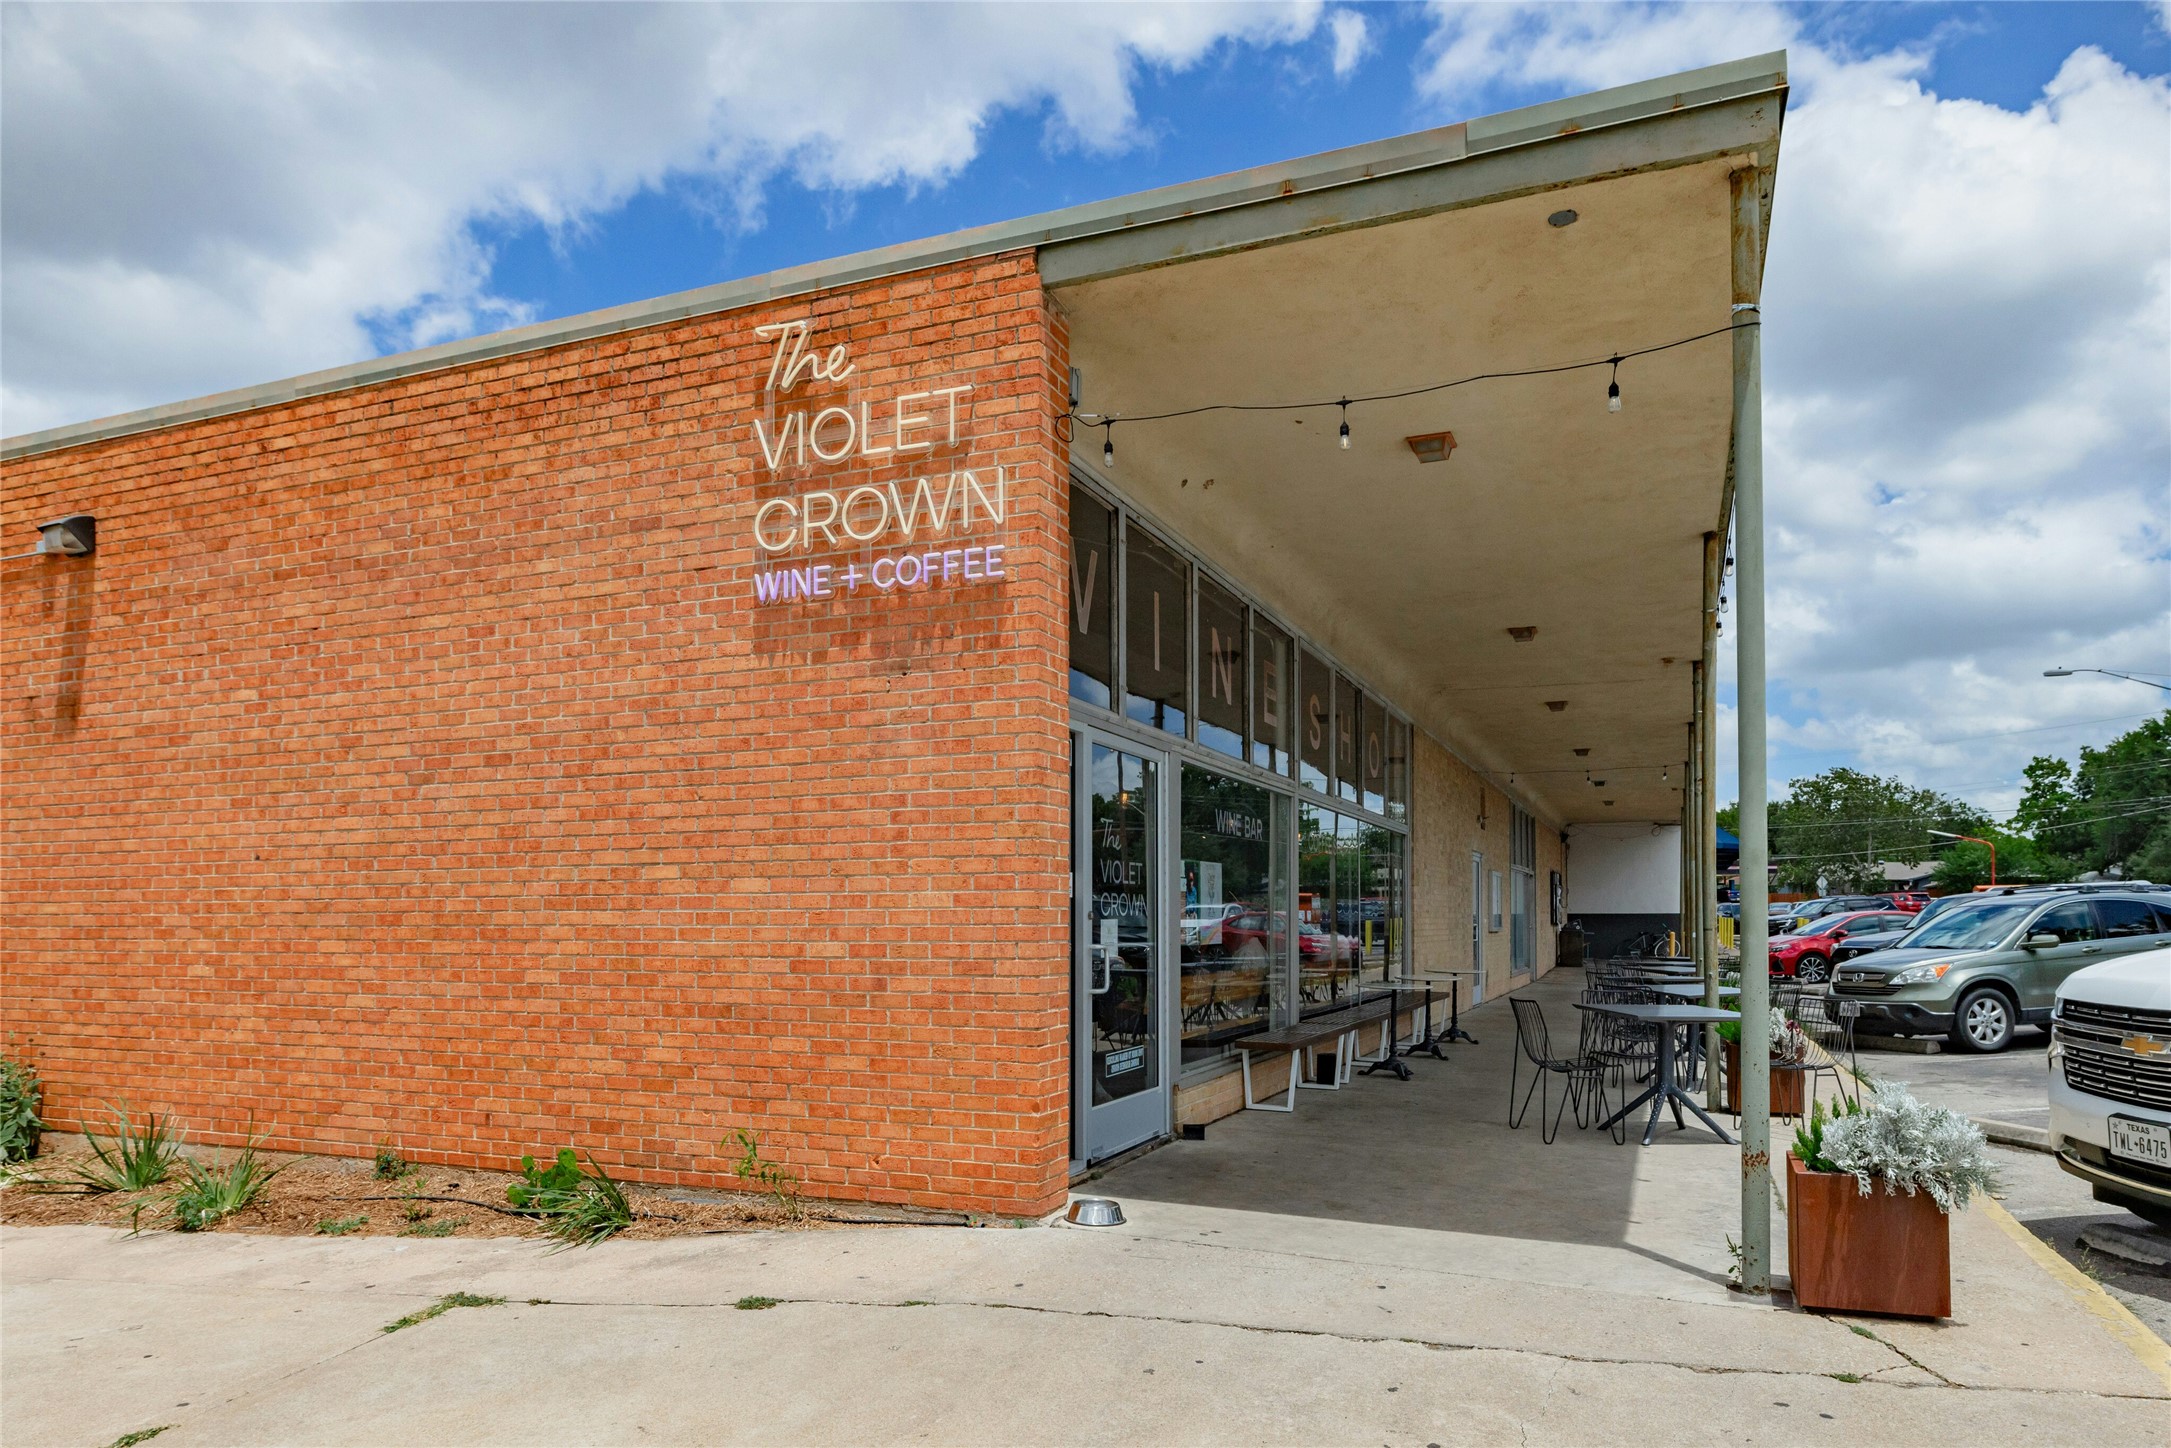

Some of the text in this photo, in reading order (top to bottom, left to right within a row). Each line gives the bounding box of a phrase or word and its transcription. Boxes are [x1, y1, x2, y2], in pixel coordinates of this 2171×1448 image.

[755, 320, 857, 392] The
[754, 384, 975, 470] VIOLET
[754, 466, 1005, 551] CROWN
[754, 544, 1006, 602] WINE + COFFEE
[1100, 817, 1122, 851] The
[1215, 808, 1263, 841] WINE BAR
[1100, 858, 1143, 885] VIOLET
[1100, 892, 1148, 917] CROWN
[2126, 1123, 2150, 1135] TEXAS
